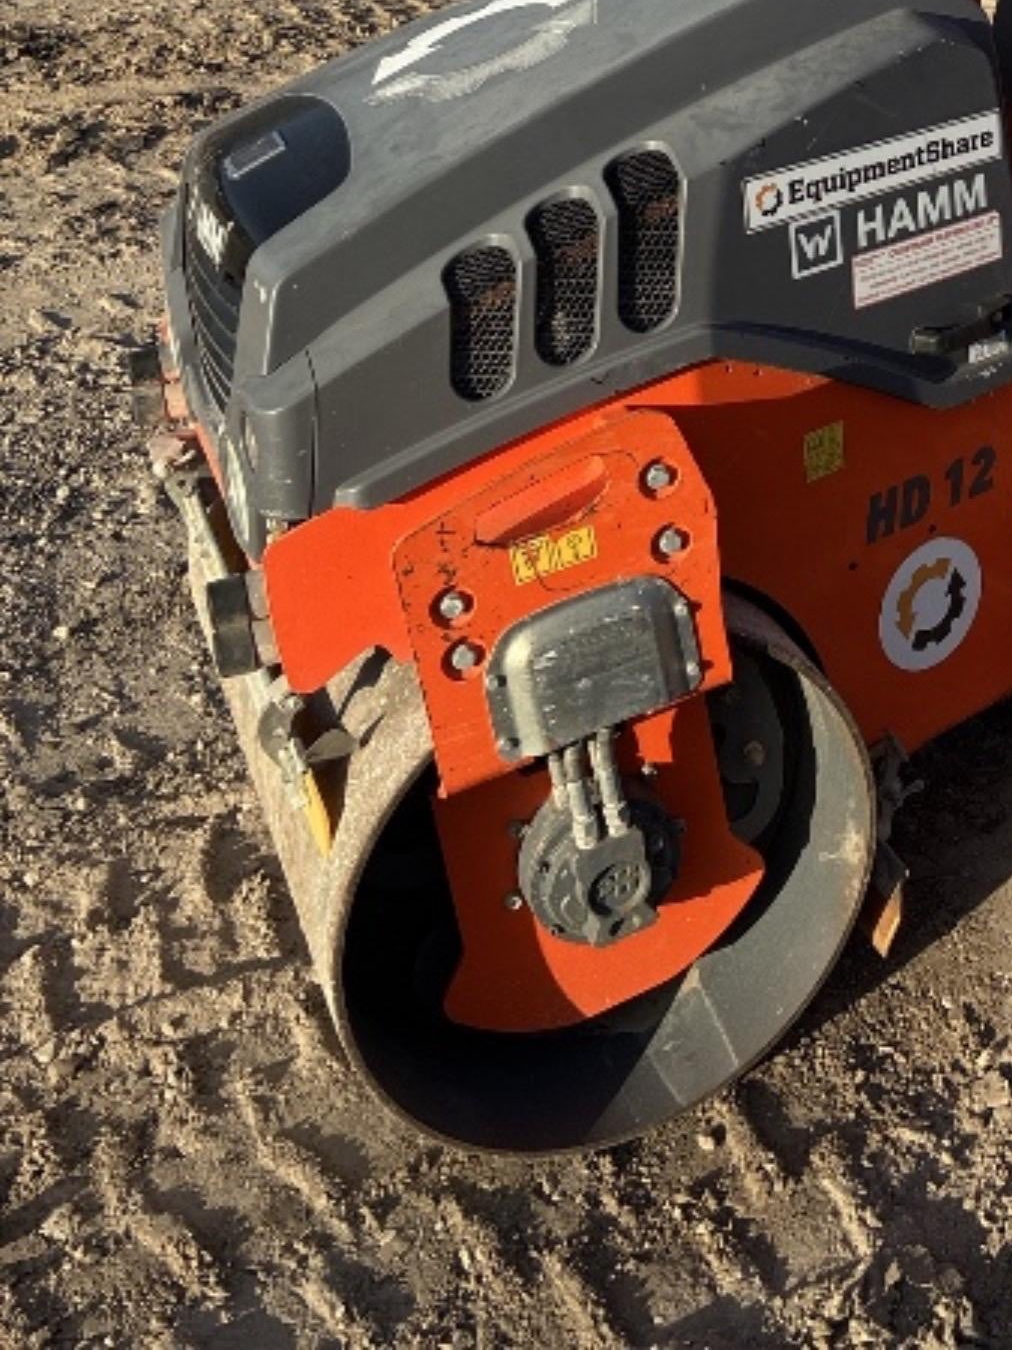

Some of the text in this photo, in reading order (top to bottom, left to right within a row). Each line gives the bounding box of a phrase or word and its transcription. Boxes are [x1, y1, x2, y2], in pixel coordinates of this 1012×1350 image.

[788, 130, 994, 205] EquipmentShare
[857, 173, 988, 248] HAMM
[866, 445, 996, 545] HD 12
